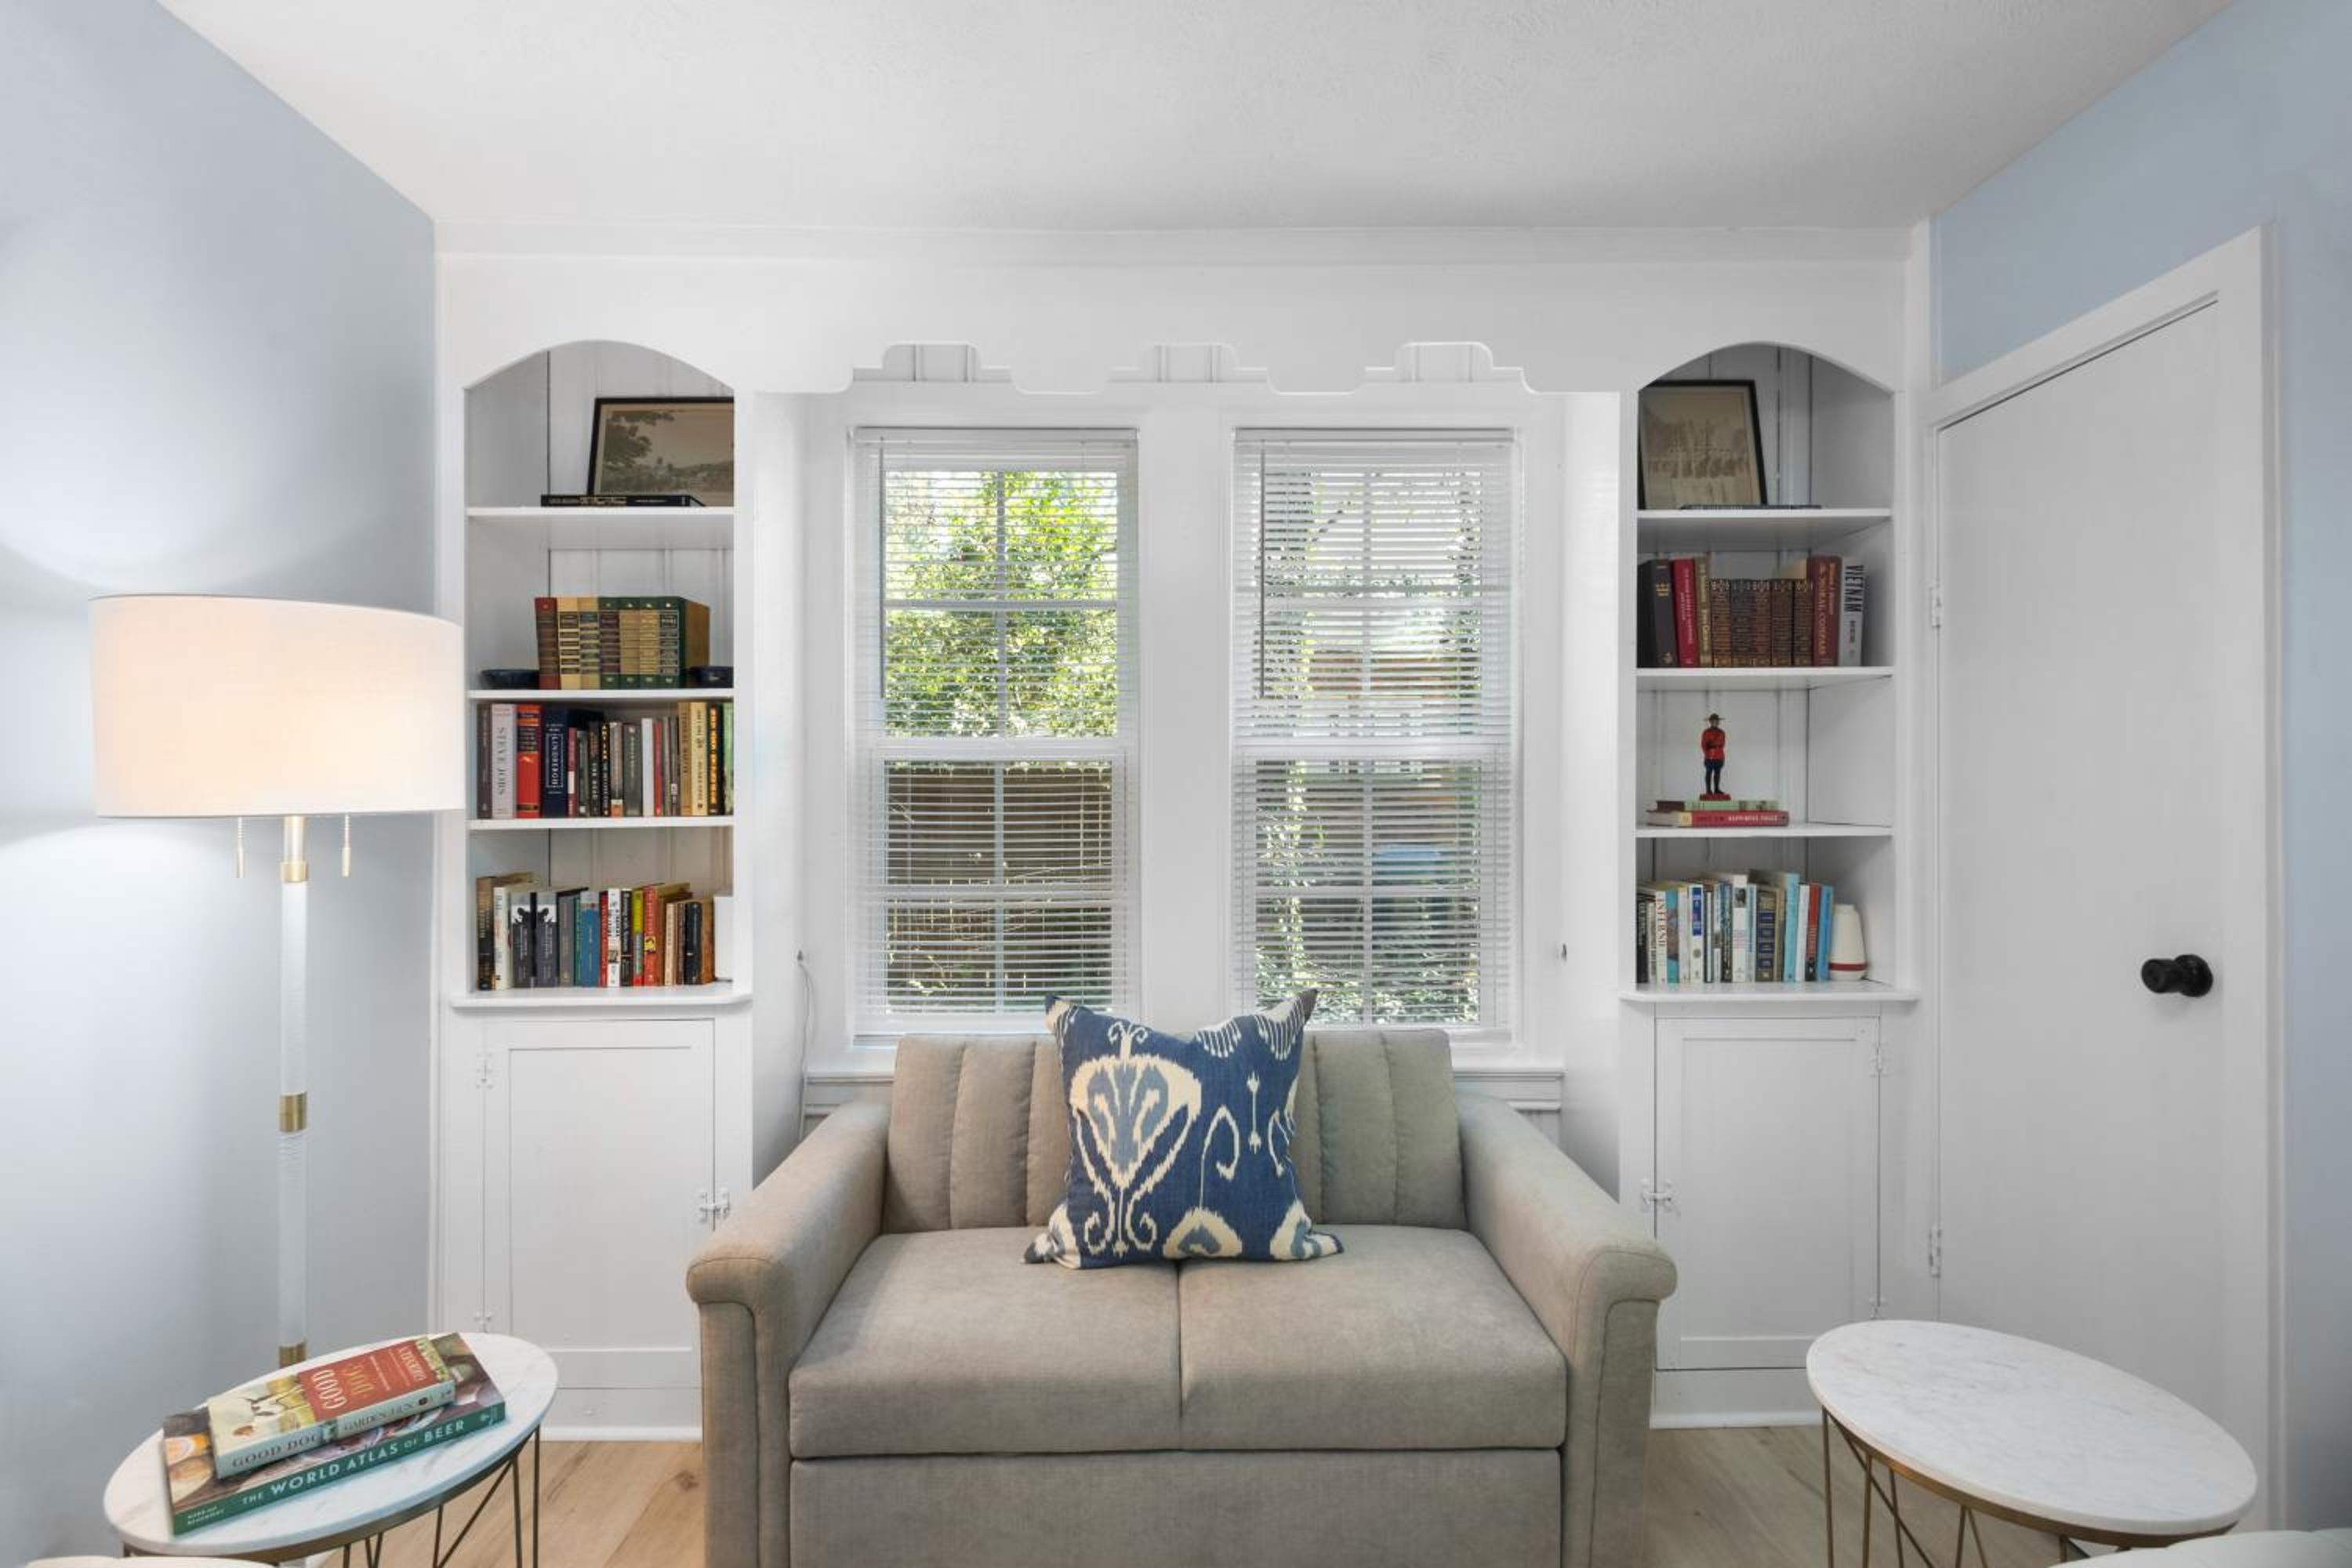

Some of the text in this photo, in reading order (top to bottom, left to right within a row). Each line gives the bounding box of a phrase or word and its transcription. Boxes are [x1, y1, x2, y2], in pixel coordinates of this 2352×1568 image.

[1844, 564, 1864, 612] VIETNAM
[496, 727, 507, 796] STEVE JOBS
[550, 735, 560, 785] LINDBERGH
[311, 1369, 348, 1410] GOOD
[232, 1445, 281, 1468] GOOD
[241, 1491, 263, 1505] THE
[270, 1464, 340, 1495] WORLD
[347, 1443, 399, 1470] ATLAS
[424, 1420, 465, 1443] BEER
